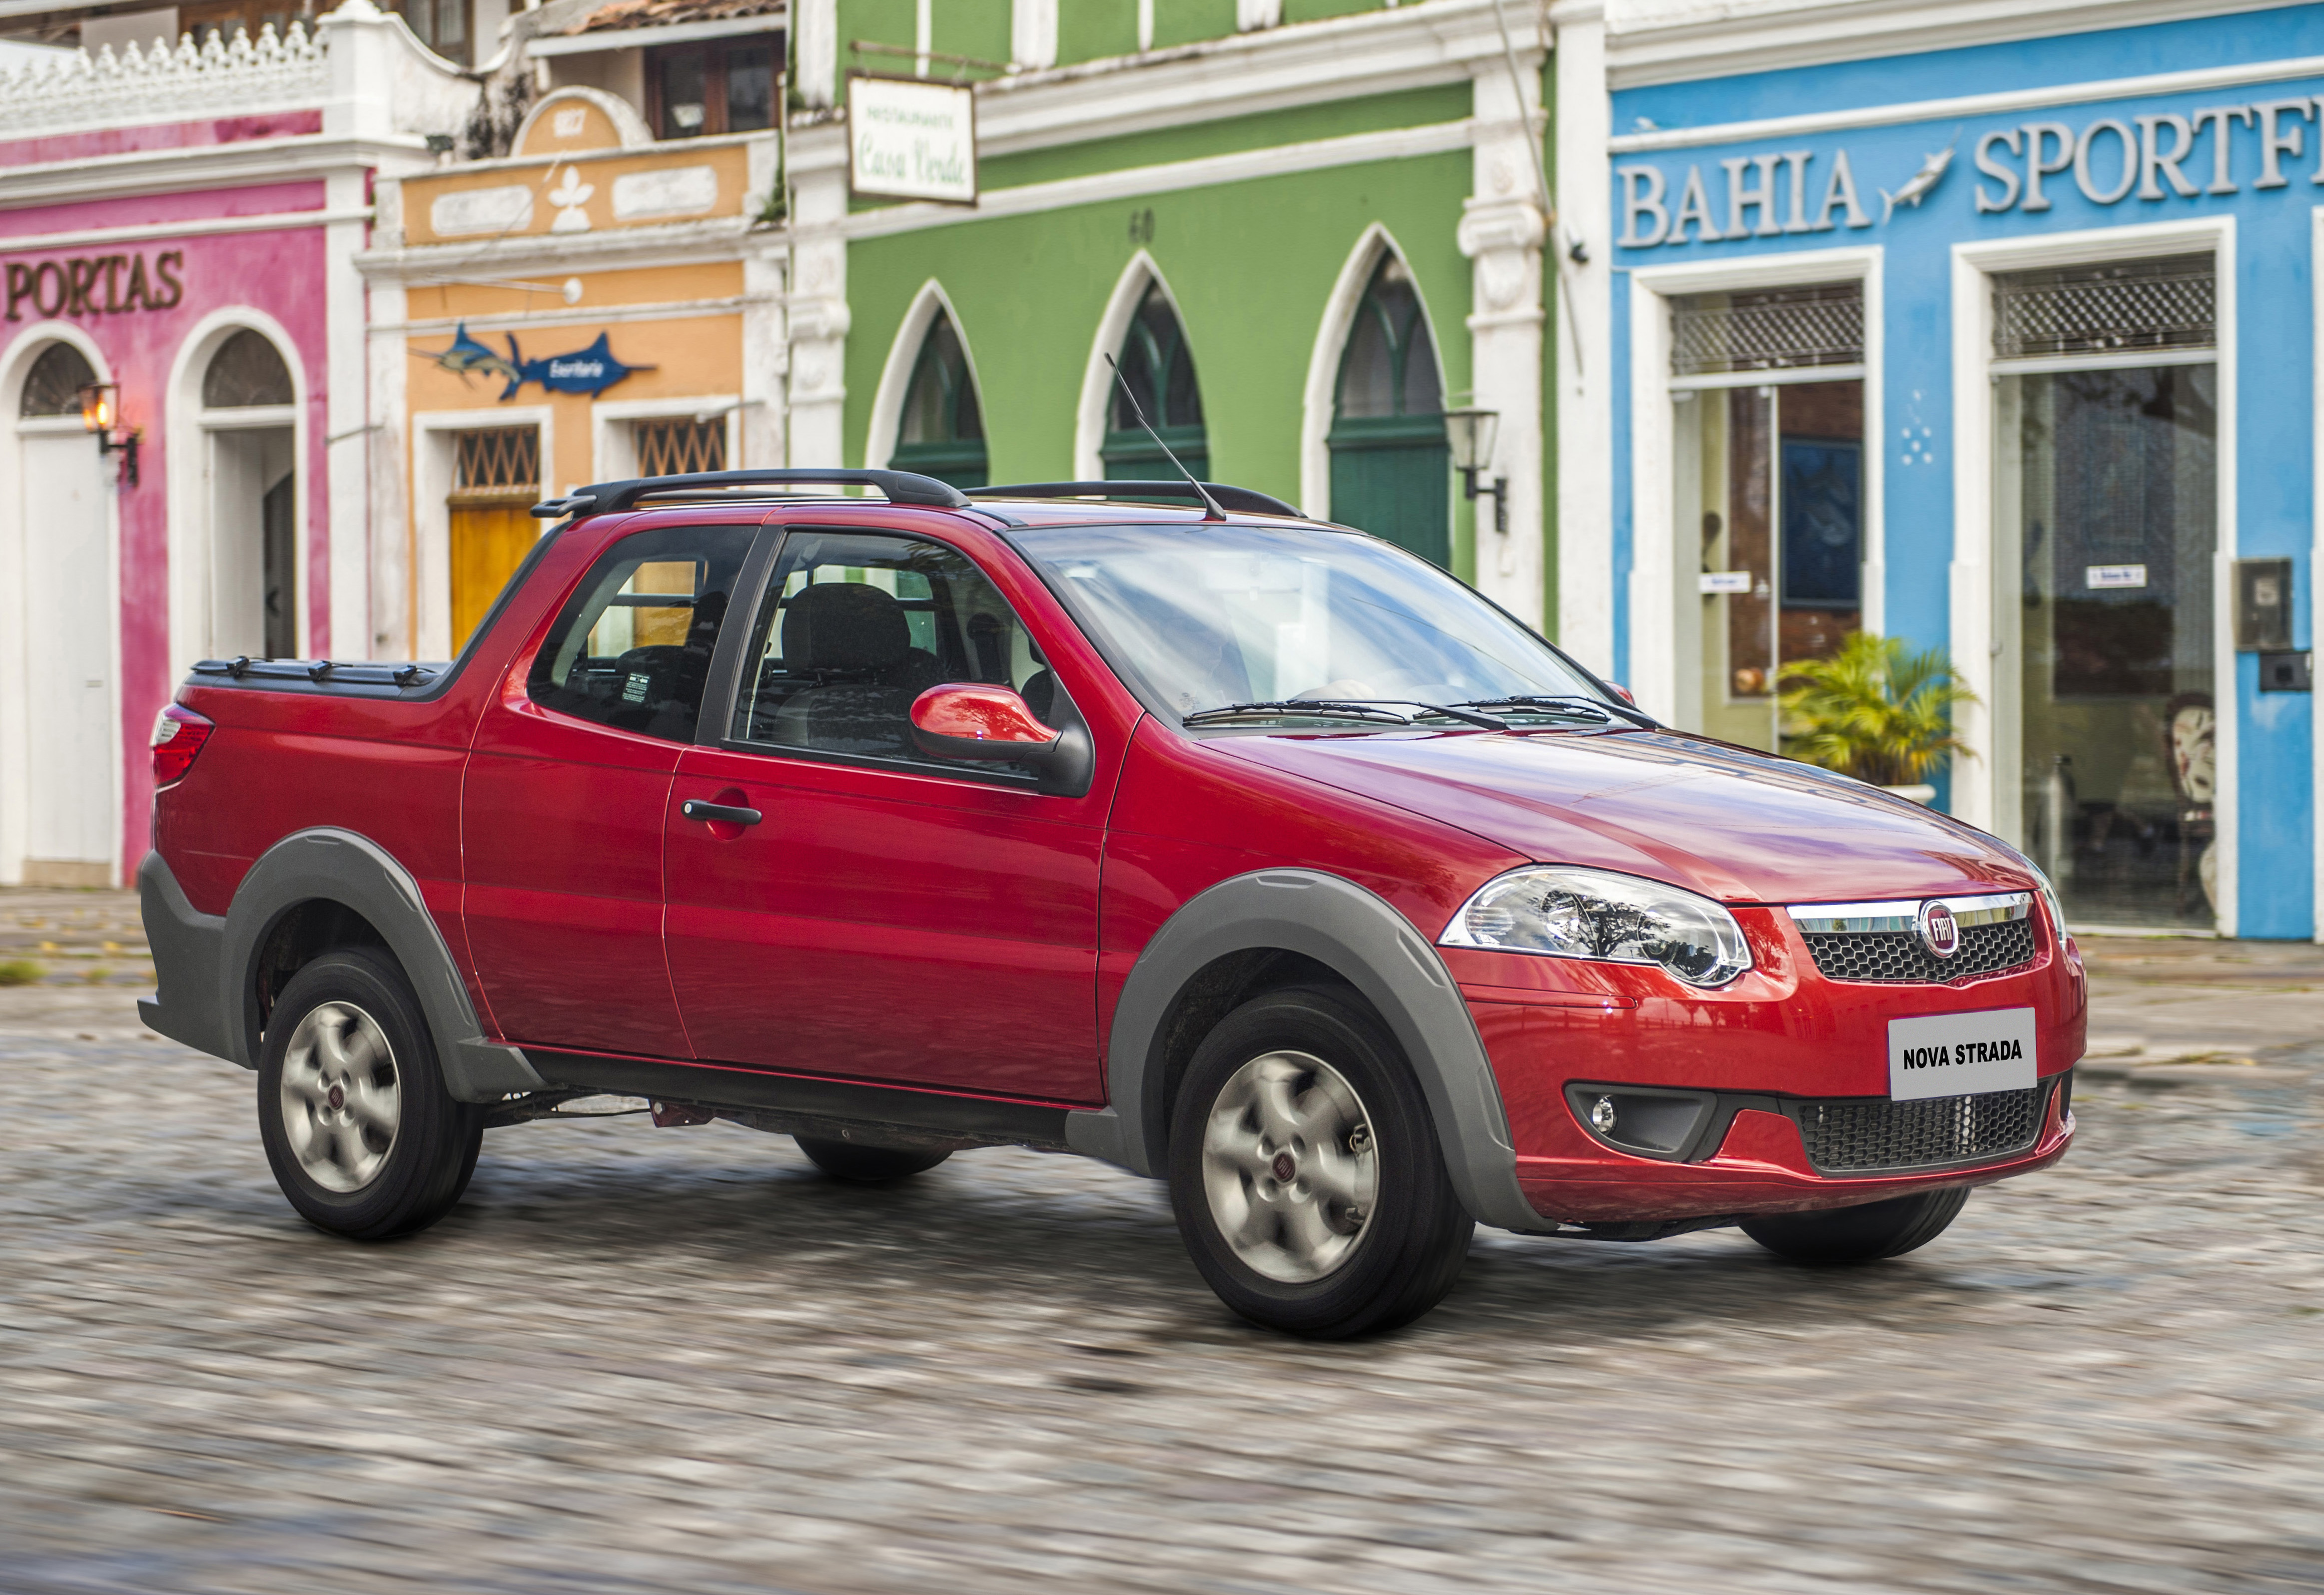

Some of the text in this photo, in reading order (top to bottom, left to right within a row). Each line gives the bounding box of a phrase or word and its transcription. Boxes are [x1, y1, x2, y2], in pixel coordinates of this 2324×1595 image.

[1617, 148, 1873, 248] BAHIA
[4, 250, 183, 322] PORTAS
[1931, 918, 1952, 941] FIAT
[1903, 1040, 2022, 1069] NOVA STRADA
